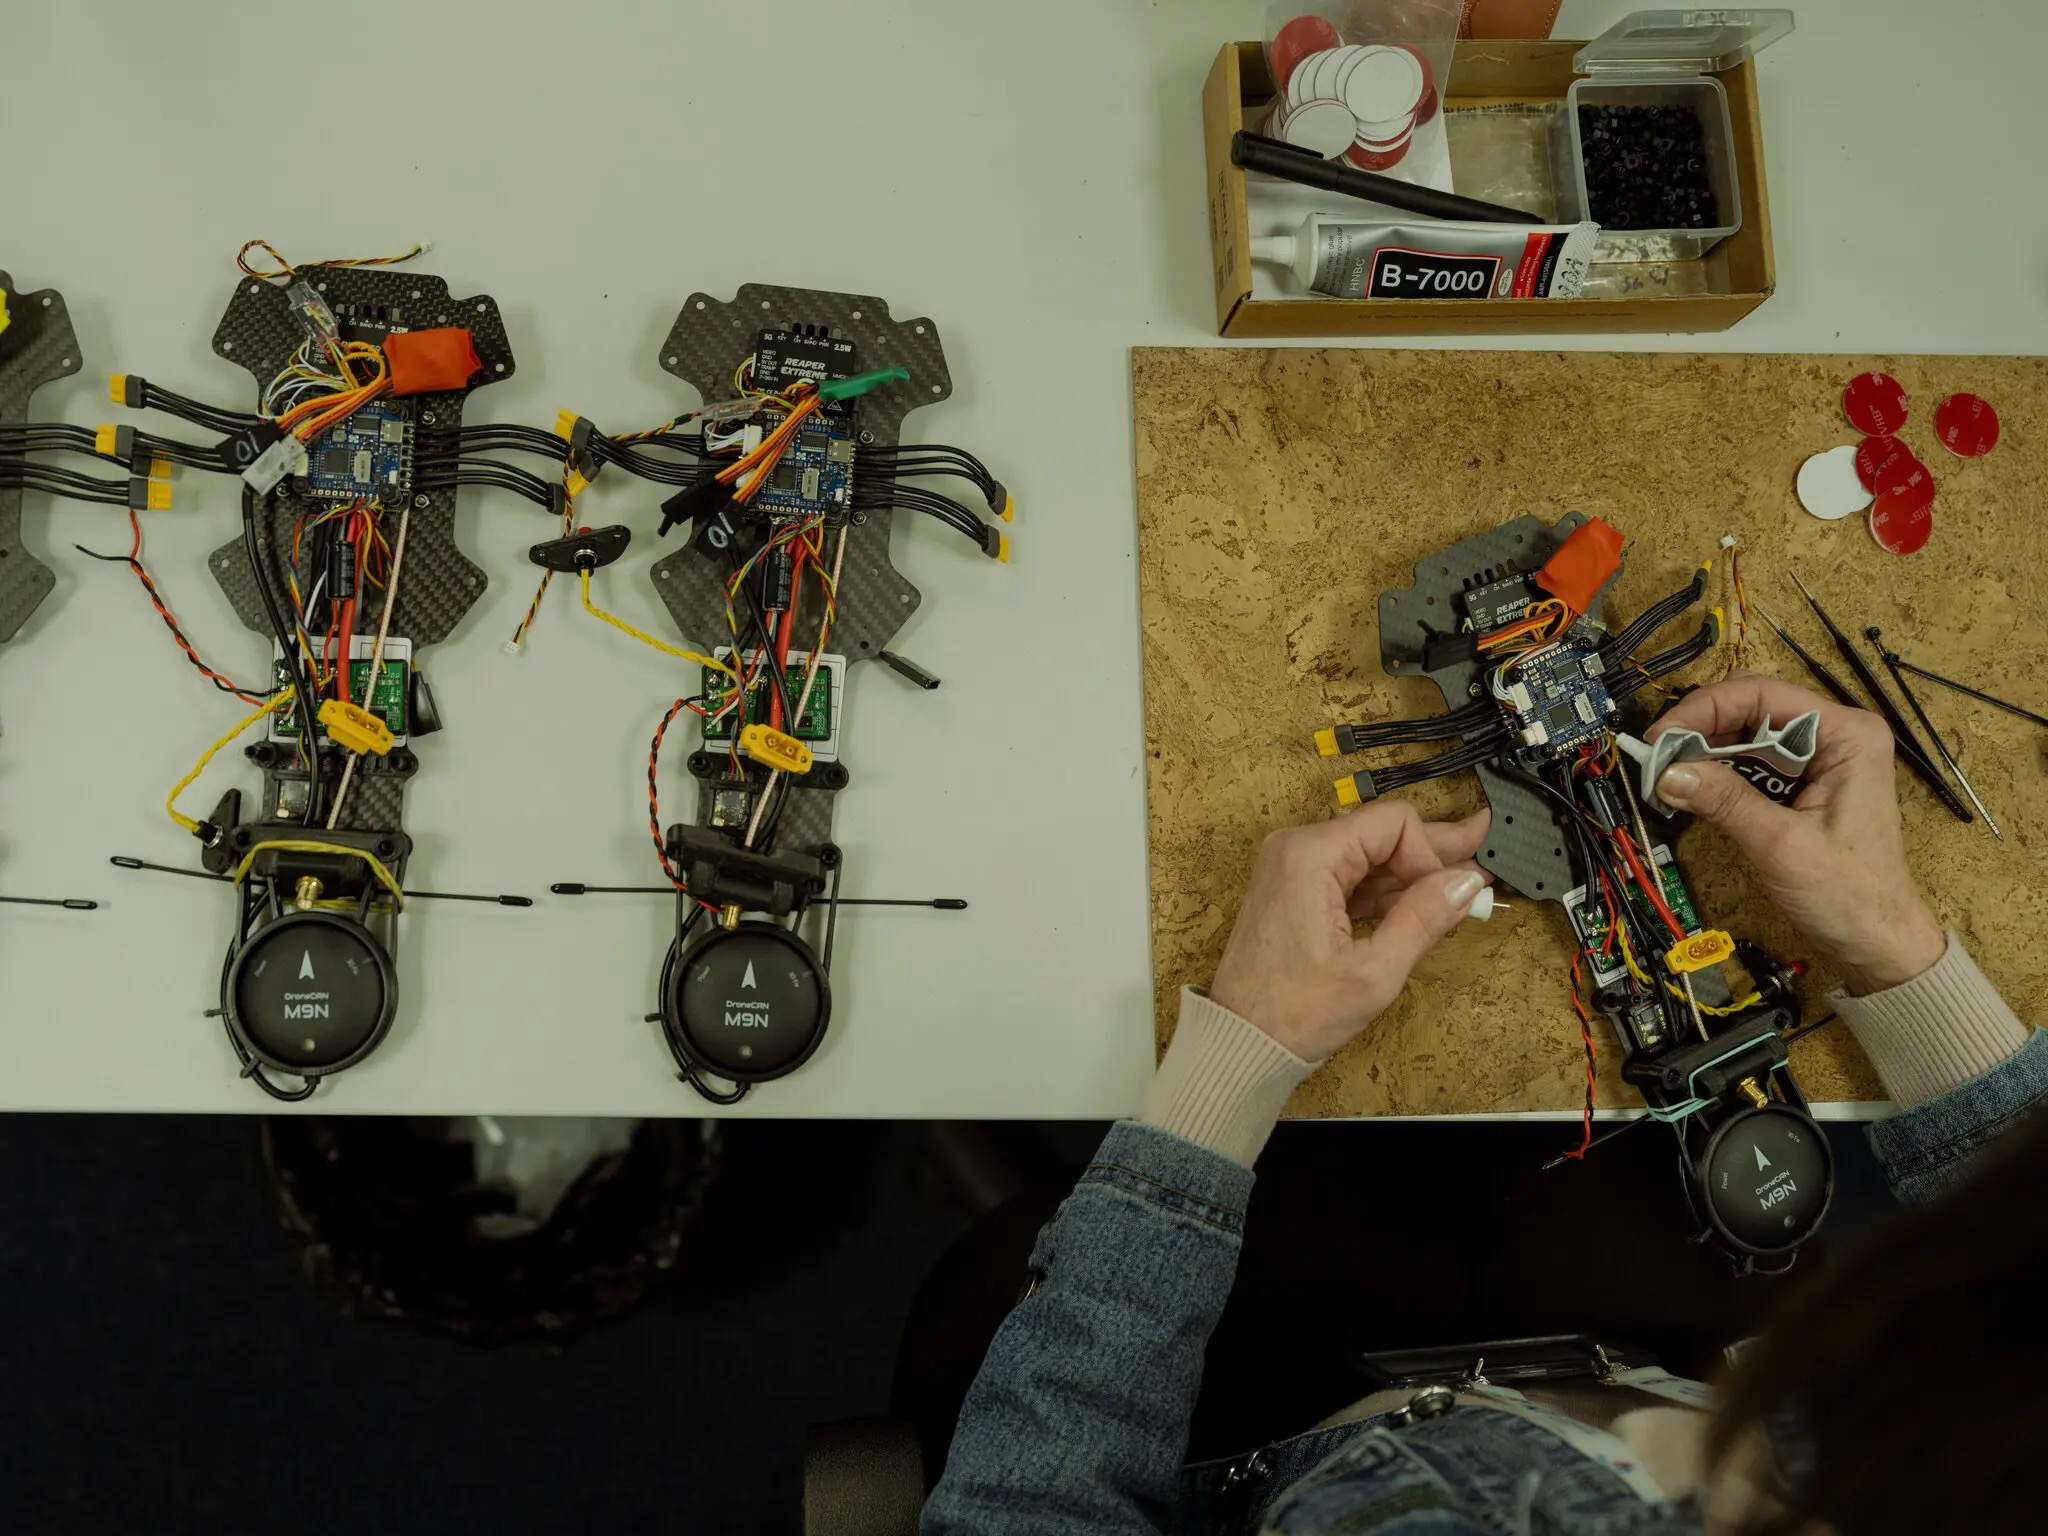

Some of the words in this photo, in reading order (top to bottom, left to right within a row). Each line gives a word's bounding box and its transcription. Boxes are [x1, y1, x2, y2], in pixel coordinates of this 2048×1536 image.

[1349, 257, 1365, 291] HNBC
[1381, 263, 1485, 292] B-7000
[780, 366, 828, 380] EXTREME
[784, 357, 826, 371] REAPER
[1858, 449, 1874, 475] VHB
[1496, 596, 1531, 615] REAPER
[284, 992, 330, 1000] DroneCAN
[725, 1000, 770, 1010] DroneCAN
[284, 1003, 329, 1020] M9N
[724, 1011, 769, 1028] M9N
[1755, 1169, 1790, 1195] DroneCAN
[1760, 1179, 1797, 1211] M9N
